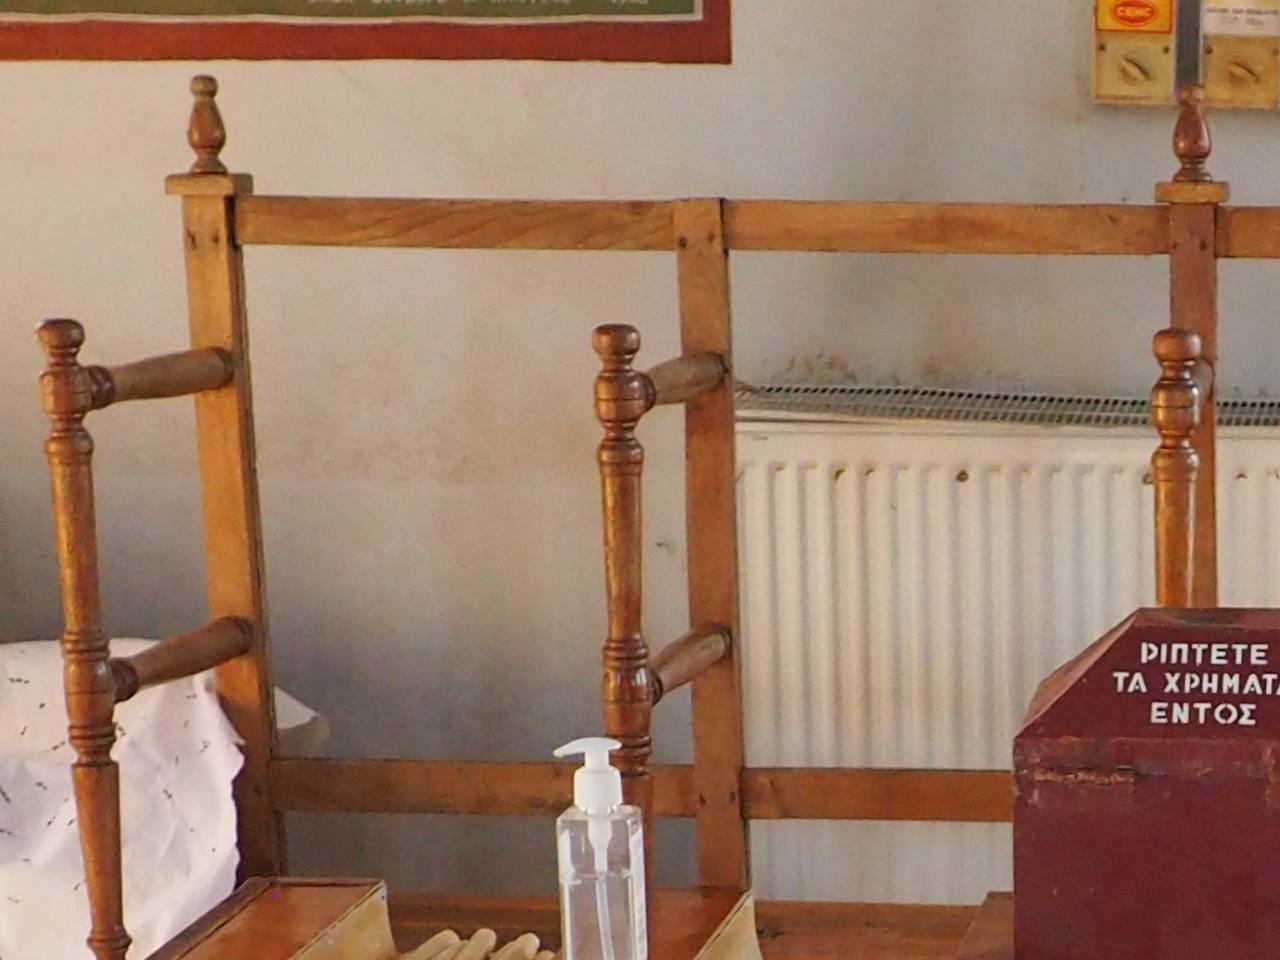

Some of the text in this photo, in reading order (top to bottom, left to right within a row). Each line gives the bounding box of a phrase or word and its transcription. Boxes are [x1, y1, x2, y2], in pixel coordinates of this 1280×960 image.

[1141, 642, 1269, 667] ΡΙΠΤΕΤΕ
[1113, 671, 1147, 693] ΤΑ
[1150, 702, 1257, 726] ΕΝΤΟΣ
